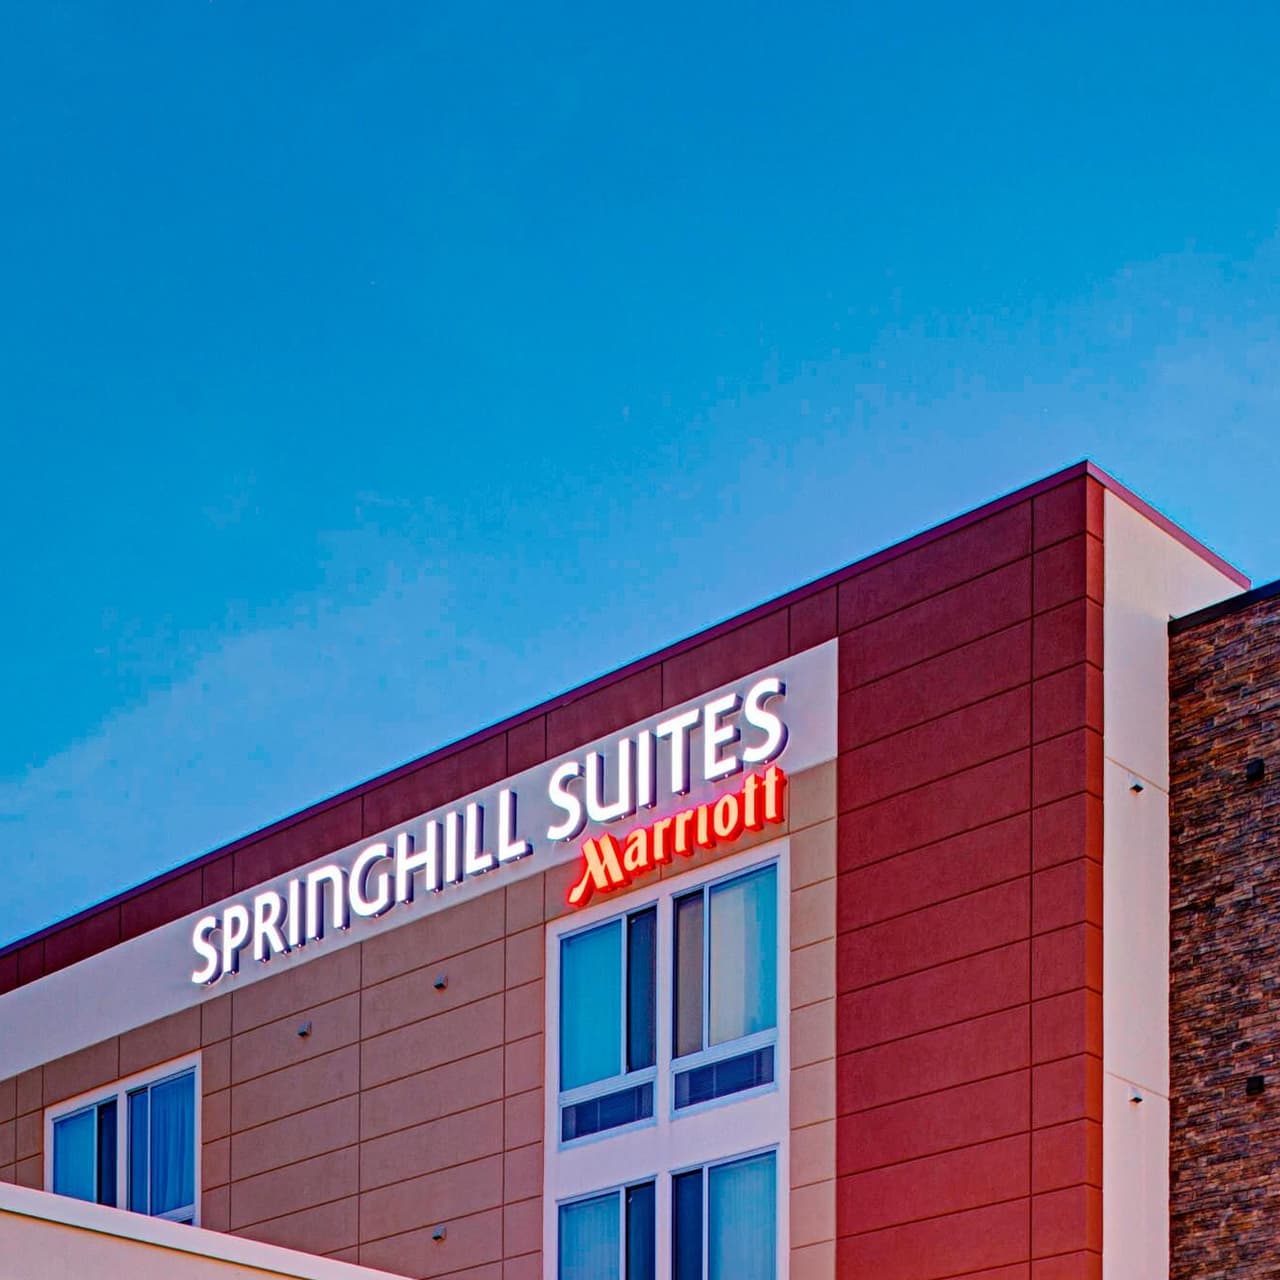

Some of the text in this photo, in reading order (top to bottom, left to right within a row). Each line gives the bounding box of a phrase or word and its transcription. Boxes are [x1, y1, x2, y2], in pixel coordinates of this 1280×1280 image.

[191, 678, 789, 985] SPRINGHILL SUITES
[568, 764, 787, 906] Marriott
